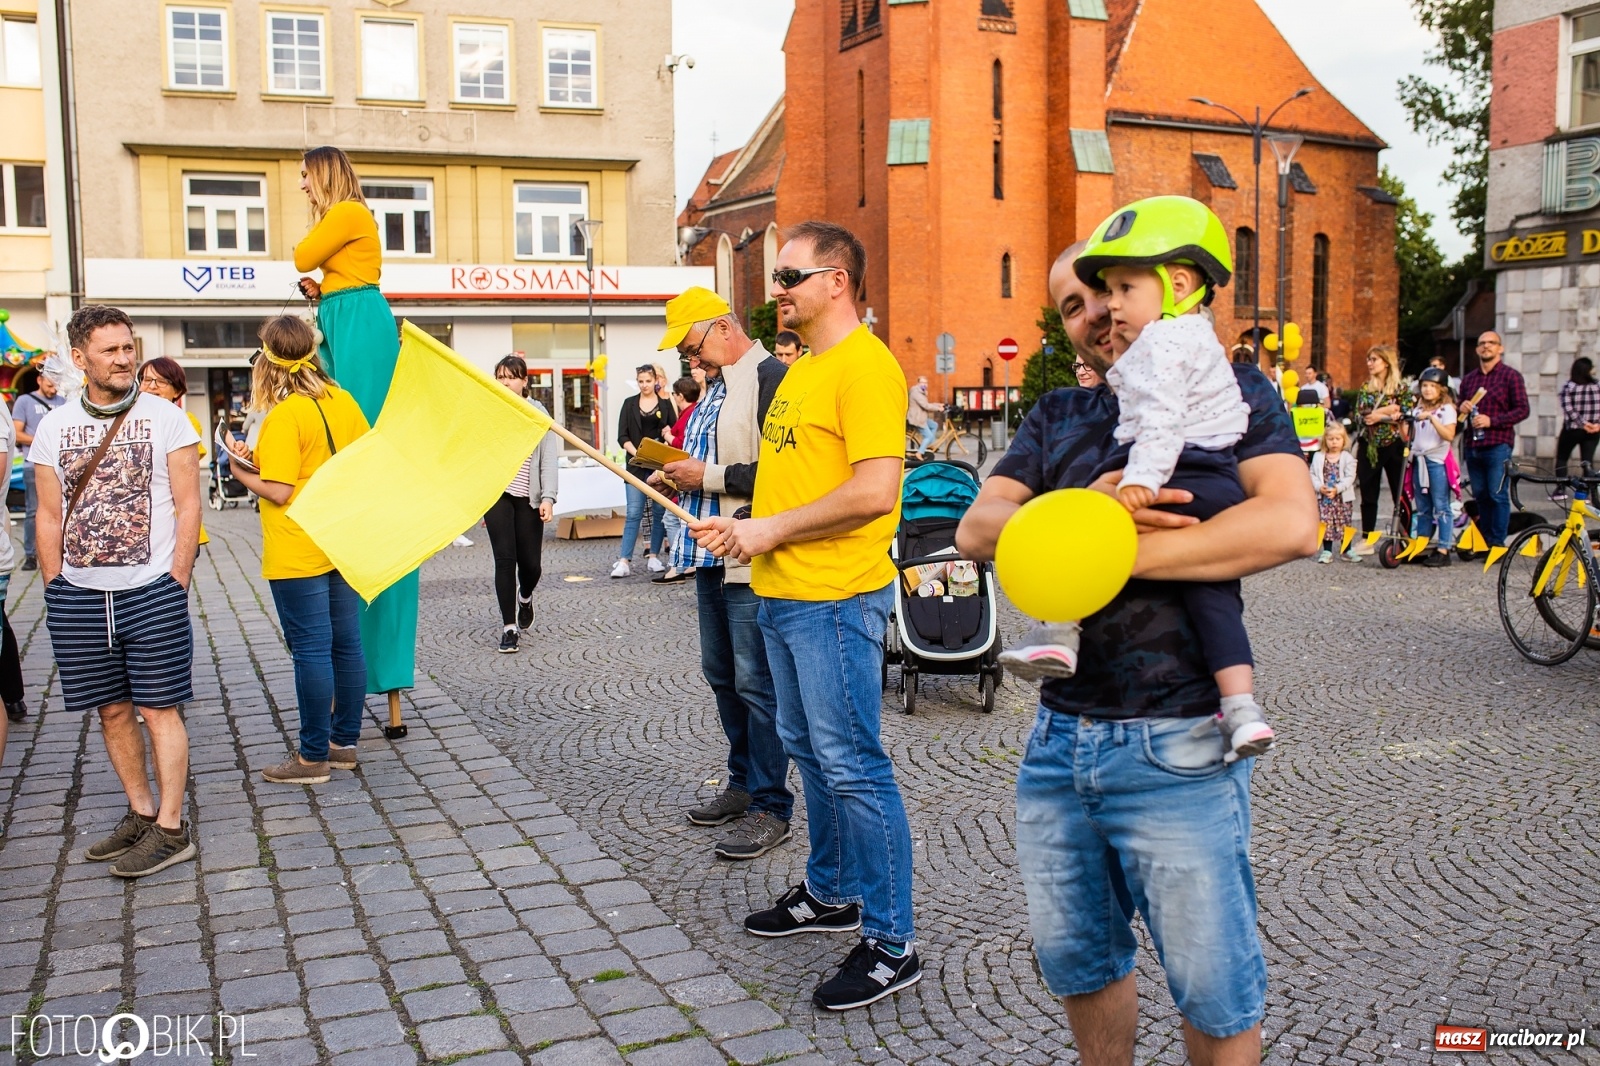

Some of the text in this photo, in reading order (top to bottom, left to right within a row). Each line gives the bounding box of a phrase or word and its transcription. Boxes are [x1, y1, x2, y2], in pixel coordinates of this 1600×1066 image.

[216, 267, 255, 280] TEB
[451, 267, 619, 290] ROSSMANN
[60, 425, 95, 448] HUG
